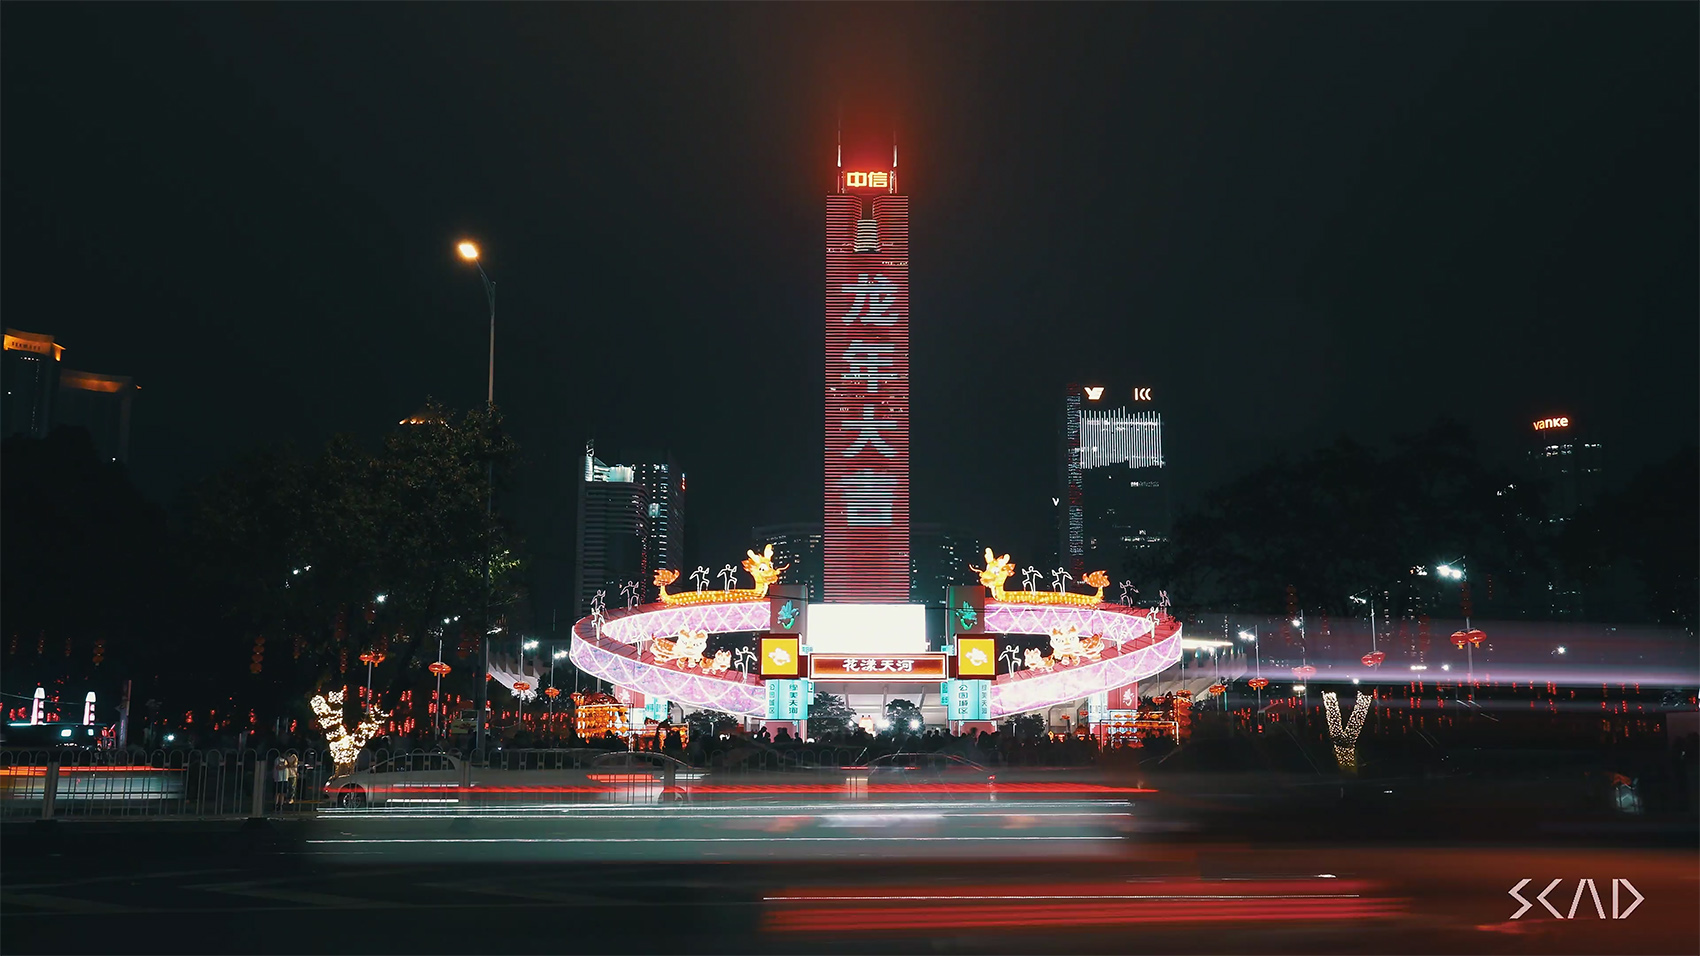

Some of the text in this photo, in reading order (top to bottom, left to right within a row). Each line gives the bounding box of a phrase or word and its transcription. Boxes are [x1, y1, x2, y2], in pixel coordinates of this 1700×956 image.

[847, 171, 888, 188] 中信
[1533, 417, 1569, 431] vanke
[842, 658, 915, 672] 花漾天河
